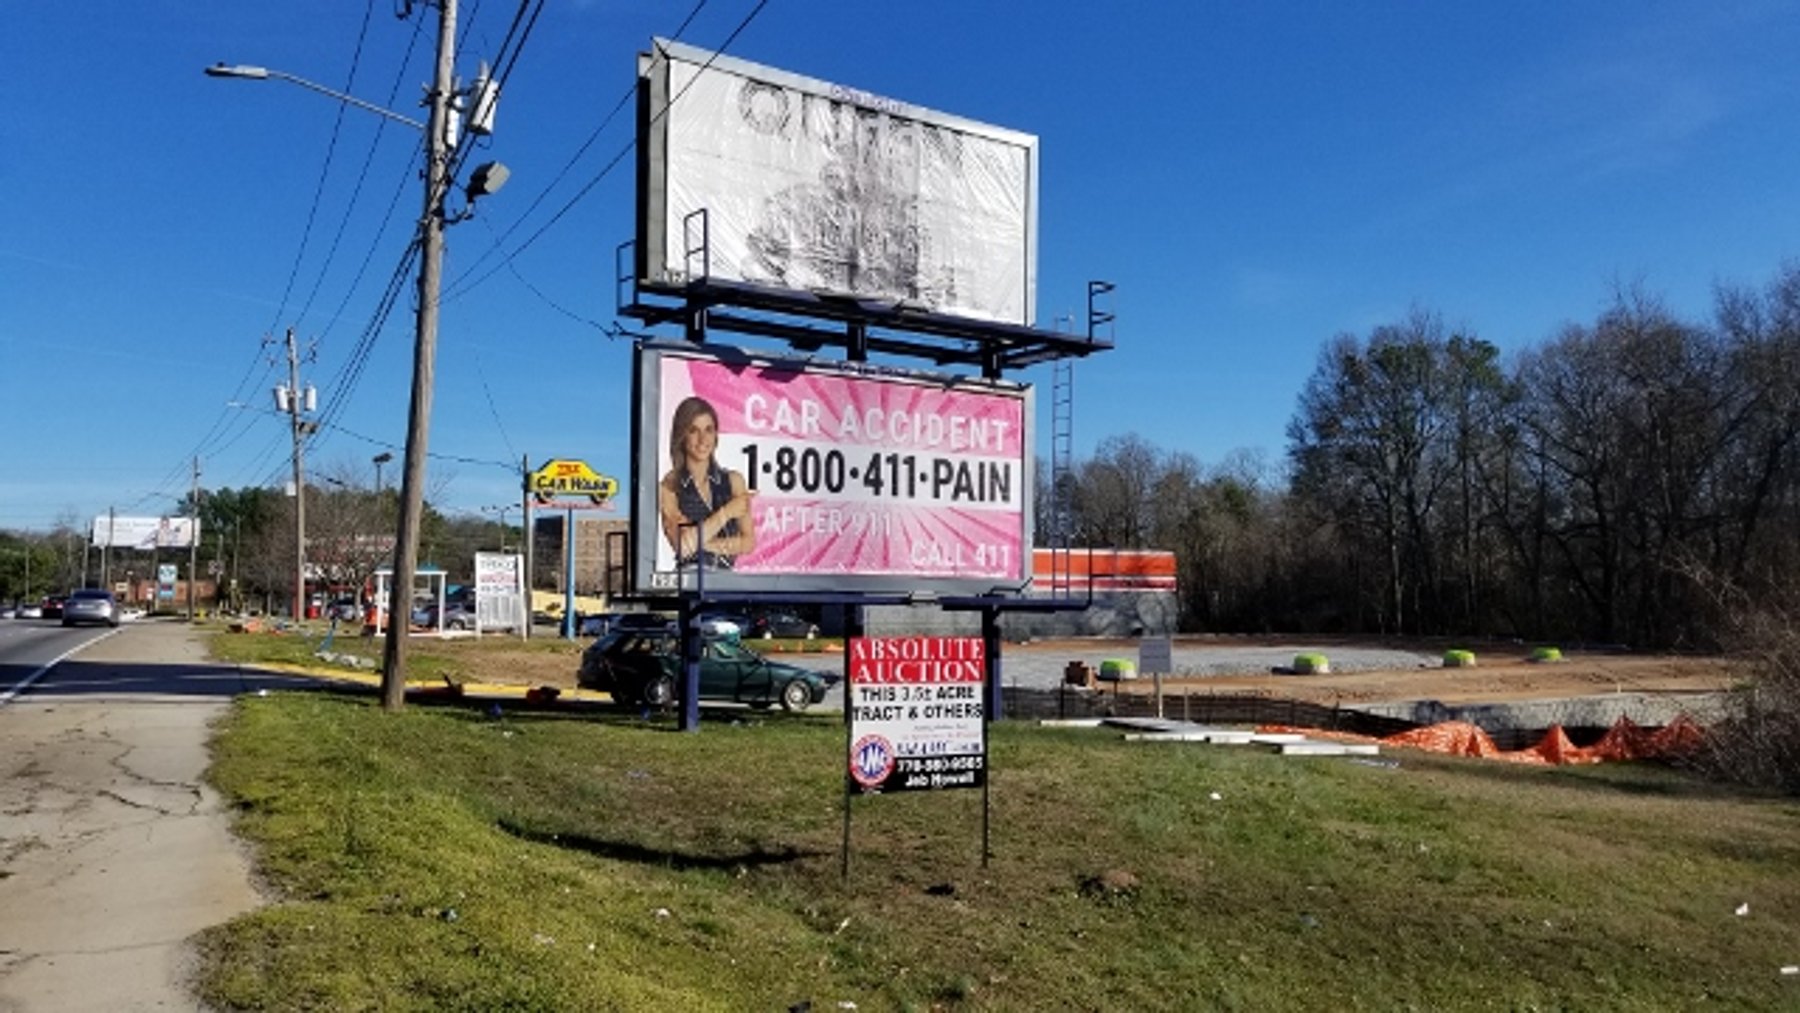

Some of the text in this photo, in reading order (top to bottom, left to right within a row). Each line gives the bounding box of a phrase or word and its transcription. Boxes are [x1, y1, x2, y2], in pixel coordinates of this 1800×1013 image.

[744, 394, 1009, 451] CAR ACCIDENT
[762, 506, 892, 537] AFTER 911
[911, 540, 1010, 567] CALL 411
[853, 637, 984, 661] ABSOLUTE
[855, 660, 981, 682] AUCTION
[860, 686, 896, 701] THIS
[936, 686, 975, 700] ACRE
[852, 705, 903, 721] TRACT
[923, 703, 983, 719] OTHERS
